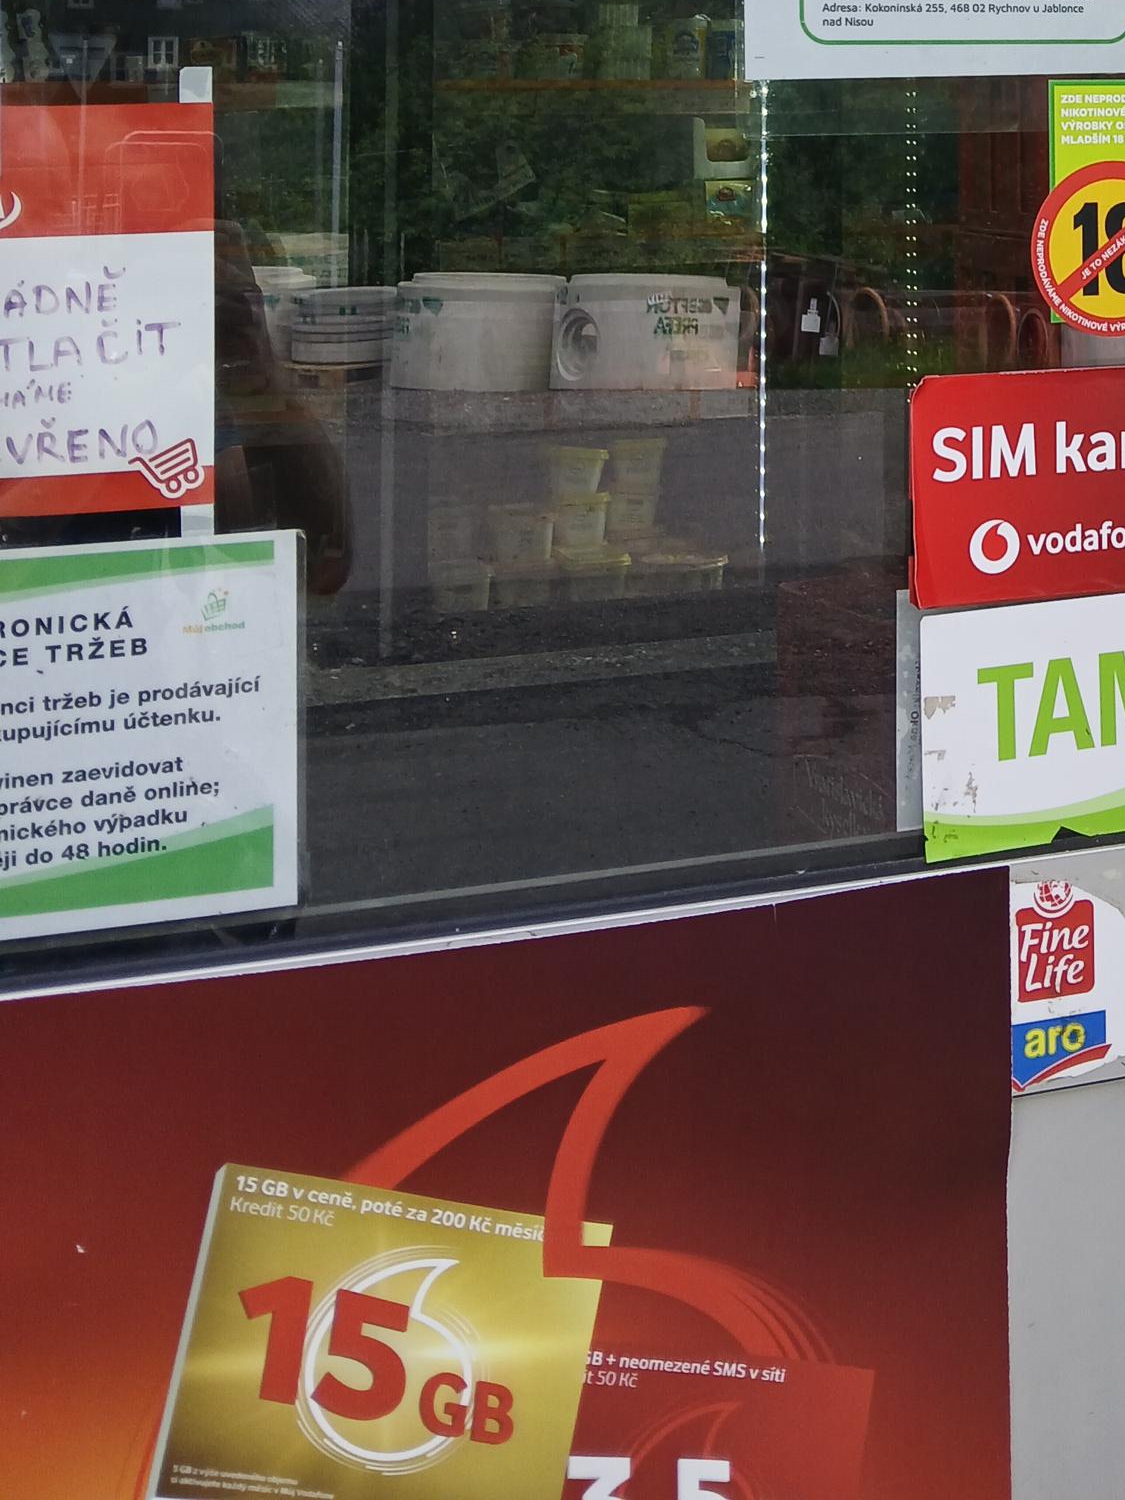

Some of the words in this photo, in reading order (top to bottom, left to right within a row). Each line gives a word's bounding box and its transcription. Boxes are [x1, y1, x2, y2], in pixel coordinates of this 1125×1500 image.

[822, 3, 862, 13] Adresa:
[865, 3, 923, 13] Kokonínská
[925, 4, 948, 15] 255,
[972, 4, 986, 14] 02
[988, 4, 1030, 15] Rychnov
[1033, 6, 1040, 14] u
[1042, 3, 1084, 14] Jablonce
[822, 17, 842, 27] nad
[844, 17, 874, 28] Nisou
[1060, 94, 1083, 104] ZDE
[1060, 119, 1113, 131] VÝROBKY
[1060, 133, 1111, 145] MLADŠÍM
[1113, 135, 1124, 144] 18
[1037, 218, 1049, 239] ZDE
[1036, 240, 1062, 307] NEPRODÁVÁME
[1081, 269, 1092, 280] JE
[1089, 258, 1102, 271] TO
[1059, 303, 1108, 332] NIKOTINOVÉ
[932, 423, 1037, 483] SIM
[45, 637, 148, 663] TRŽEB
[43, 691, 102, 712] tržeb
[108, 689, 130, 709] je
[138, 676, 261, 706] prodávající
[0, 718, 115, 744] upujícímu
[123, 708, 221, 731] účtenku.
[61, 757, 184, 784] zaevidovat
[81, 786, 136, 808] daně
[144, 780, 220, 800] online;
[93, 808, 188, 834] výpadku
[0, 850, 17, 871] ji
[25, 848, 54, 866] do
[61, 843, 90, 861] 48
[98, 836, 167, 858] hodin.
[1020, 921, 1090, 963] Fine
[1024, 953, 1085, 993] Life
[1023, 1021, 1086, 1059] aro
[230, 1196, 283, 1219] Kredit
[287, 1205, 311, 1223] 50
[312, 1209, 335, 1227] Kč
[235, 1174, 258, 1193] 15
[262, 1179, 288, 1198] GB
[292, 1186, 304, 1199] v
[307, 1186, 357, 1211] ceně,
[360, 1200, 403, 1219] poté
[406, 1206, 428, 1222] za
[431, 1208, 466, 1229] 200
[469, 1216, 491, 1234] Kč
[238, 1276, 410, 1422] 15
[419, 1372, 515, 1446] GB
[619, 1356, 711, 1376] neomezené
[713, 1360, 748, 1379] SMS
[749, 1367, 760, 1380] v
[761, 1367, 787, 1383] síti
[595, 1370, 617, 1386] 50
[619, 1372, 639, 1388] Kč
